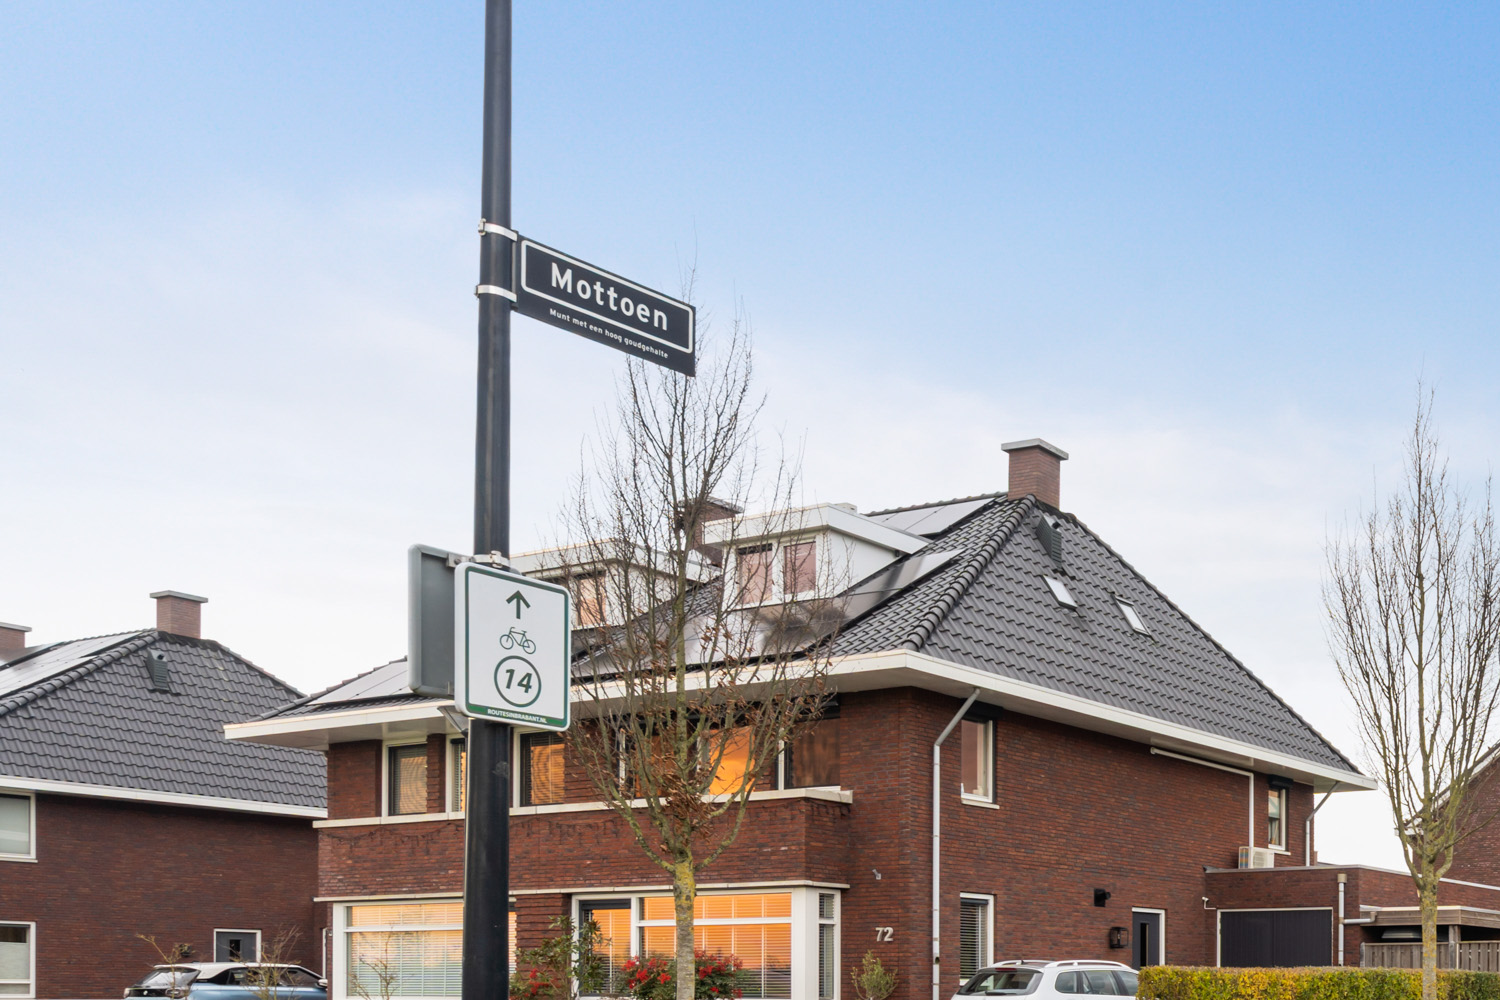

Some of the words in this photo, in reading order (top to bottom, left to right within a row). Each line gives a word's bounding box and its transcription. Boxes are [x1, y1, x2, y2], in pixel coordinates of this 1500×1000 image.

[551, 262, 668, 331] Mottoen
[549, 308, 571, 322] Munt
[572, 317, 588, 329] met
[589, 323, 603, 334] een
[604, 328, 622, 343] hoog
[624, 337, 669, 359] goudgehalte
[504, 668, 533, 694] 14
[487, 708, 548, 724] ROUTESINBRABANT.NL
[875, 926, 894, 942] 72
